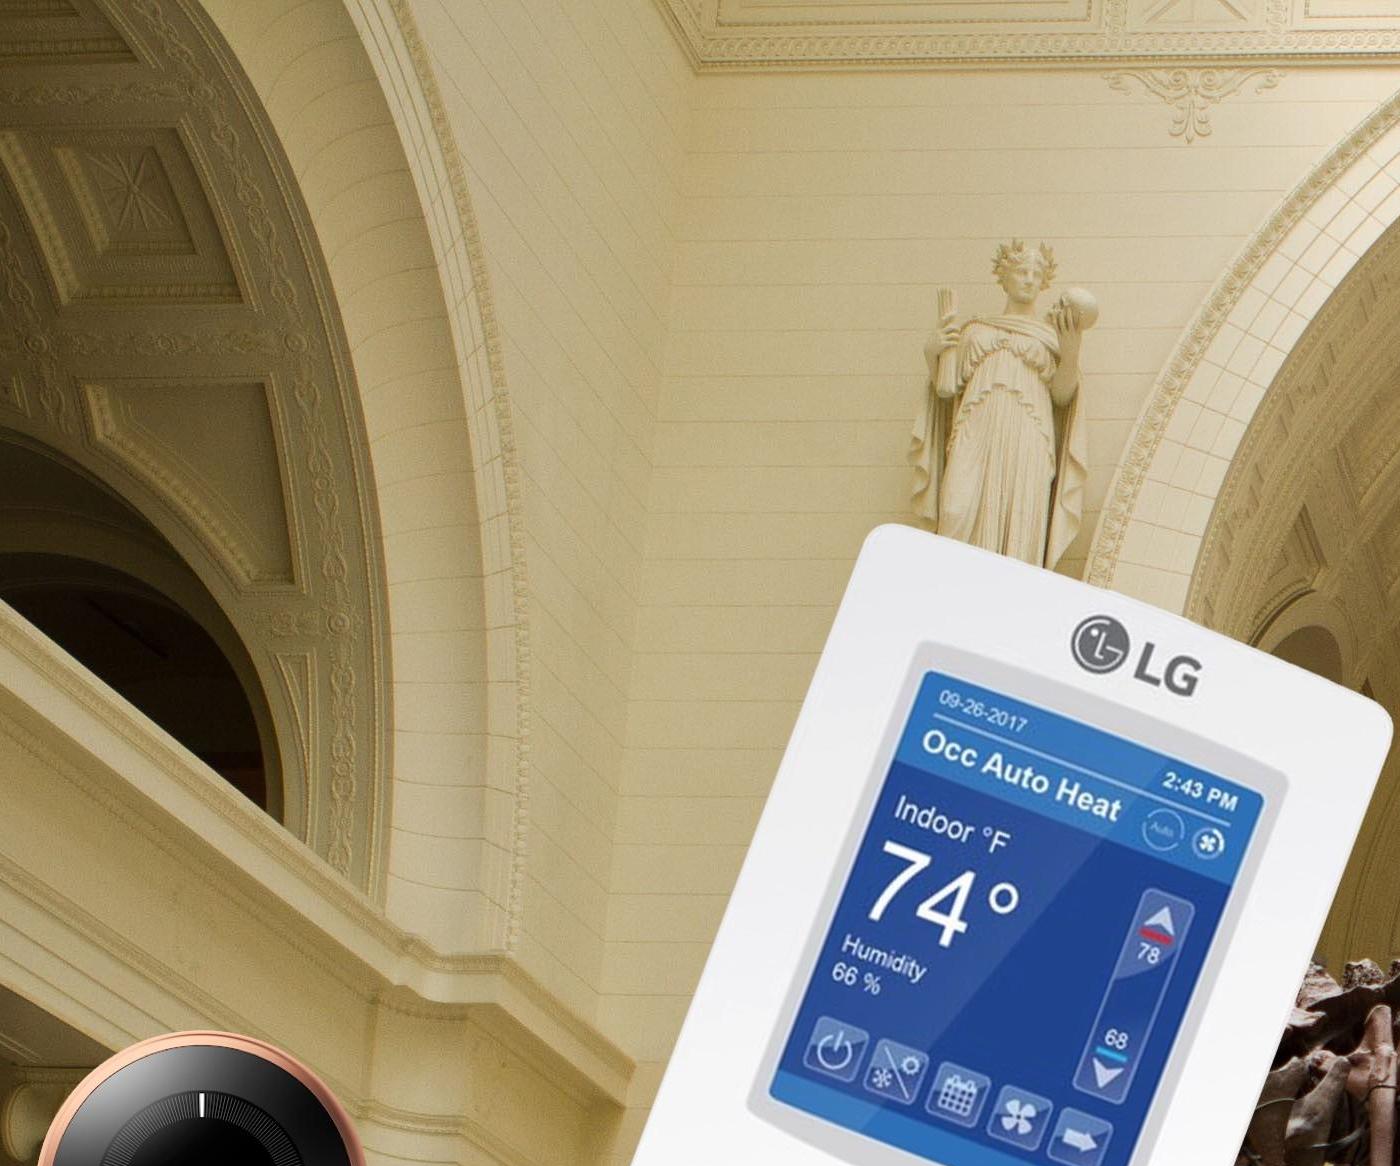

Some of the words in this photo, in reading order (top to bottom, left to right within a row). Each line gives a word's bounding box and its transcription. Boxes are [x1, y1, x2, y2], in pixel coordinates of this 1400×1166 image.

[1133, 641, 1203, 697] LG
[938, 688, 1028, 733] 09-26-2017
[922, 729, 978, 767] Occ
[981, 753, 1049, 795] Auto
[1055, 777, 1123, 822] Heat
[1161, 771, 1203, 799] 2:43
[1206, 786, 1238, 812] PM
[894, 795, 975, 843] Indoor
[831, 961, 859, 986] 66
[841, 934, 927, 985] Humidity
[1137, 942, 1161, 964] 78
[1104, 1028, 1129, 1050] 68
